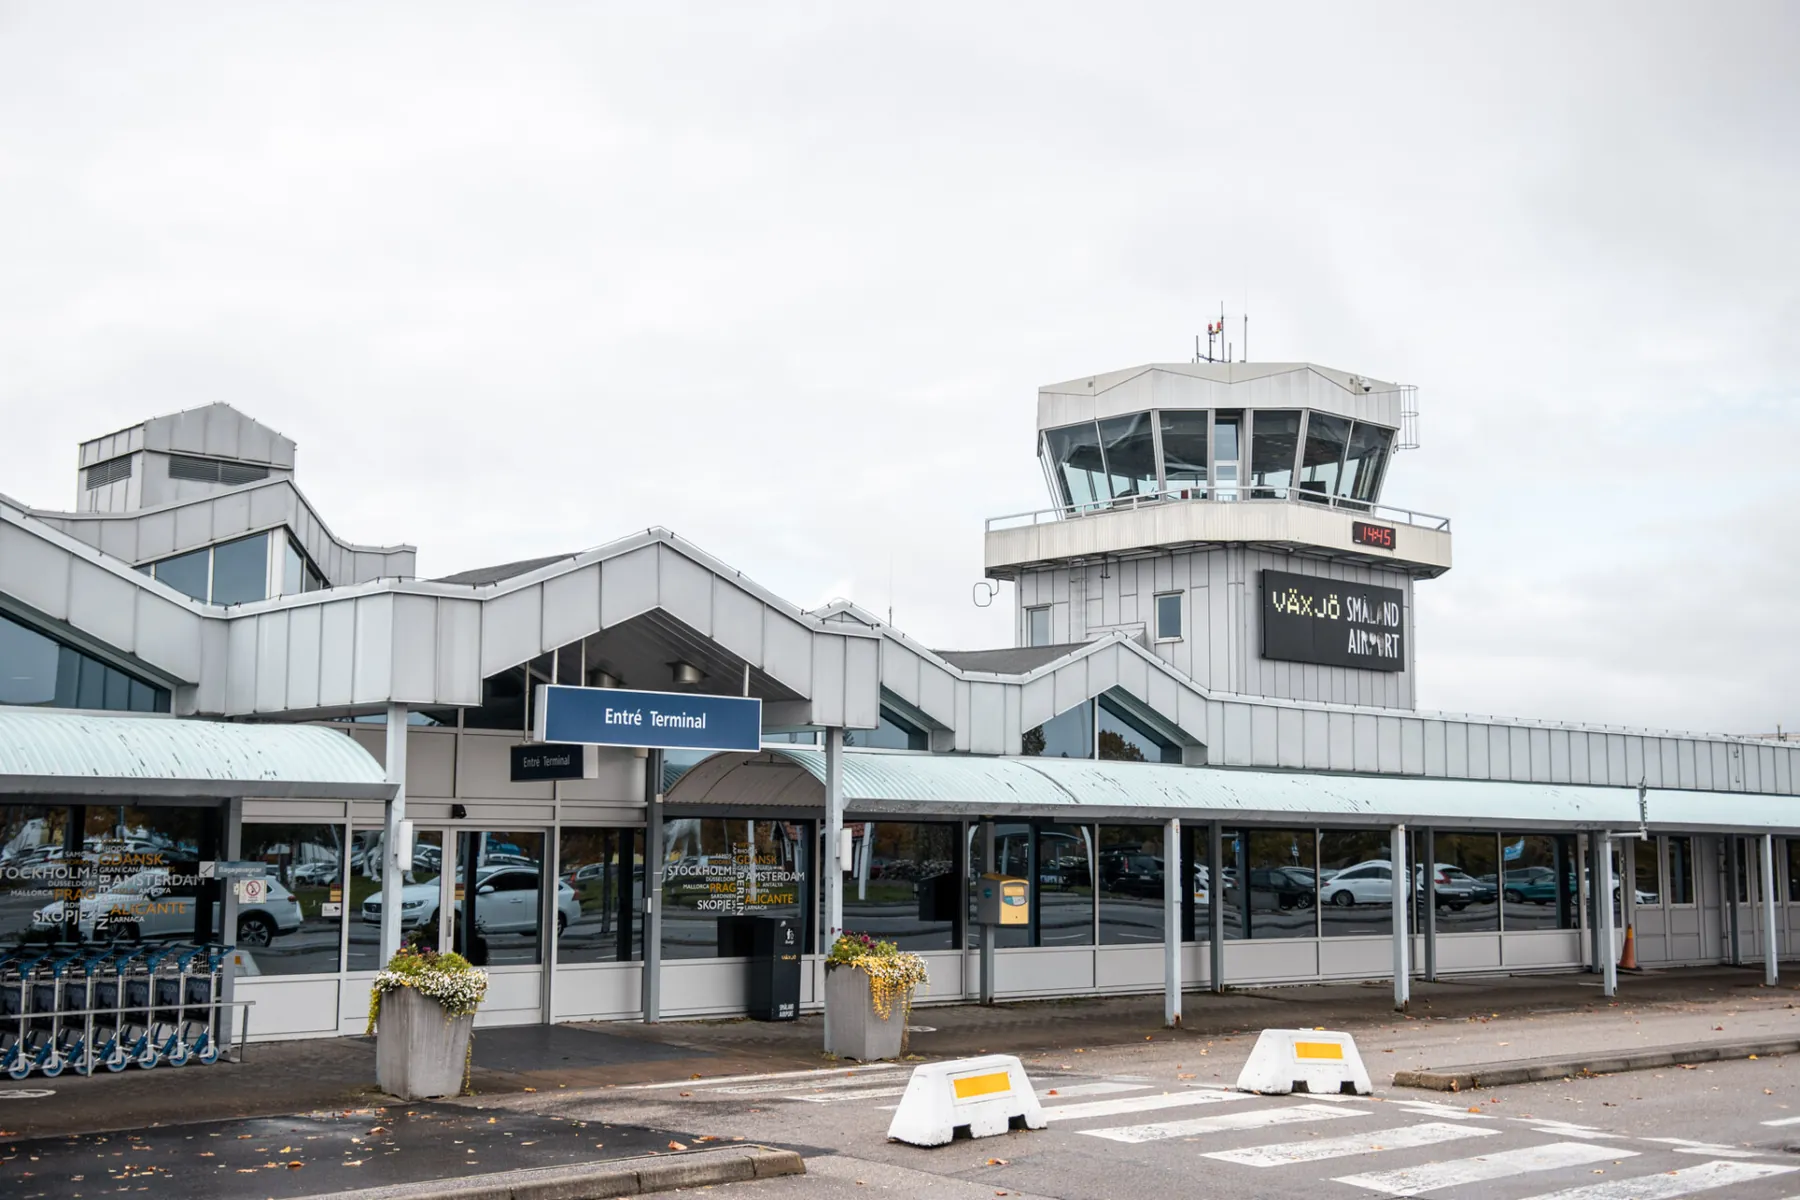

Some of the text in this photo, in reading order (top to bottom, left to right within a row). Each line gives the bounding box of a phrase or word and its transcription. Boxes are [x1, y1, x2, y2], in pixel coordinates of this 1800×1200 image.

[1363, 526, 1391, 546] 14:45
[1272, 587, 1399, 627] VÄXJÖ SMÅLAND
[1347, 628, 1400, 659] AIRPORT
[605, 707, 706, 729] Entré Terminal
[523, 754, 571, 768] Entré Terminal
[99, 853, 164, 866] GDANSK
[736, 854, 778, 866] GDANSK
[0, 867, 90, 880] TOCKHOLM
[668, 865, 732, 876] STOCKHOLM
[745, 871, 805, 882] AMSTERDAM
[112, 873, 206, 887] AMSTERDAM
[11, 889, 53, 897] MALLORCA
[709, 882, 737, 893] PRAG
[736, 871, 745, 916] BERLIN
[53, 888, 96, 902] PRAG
[745, 893, 794, 905] ALICANTE
[110, 902, 187, 915] ALICANTE
[697, 899, 732, 912] SKOPJE
[32, 909, 88, 926] SKOPJE
[109, 916, 145, 924] LARNACA
